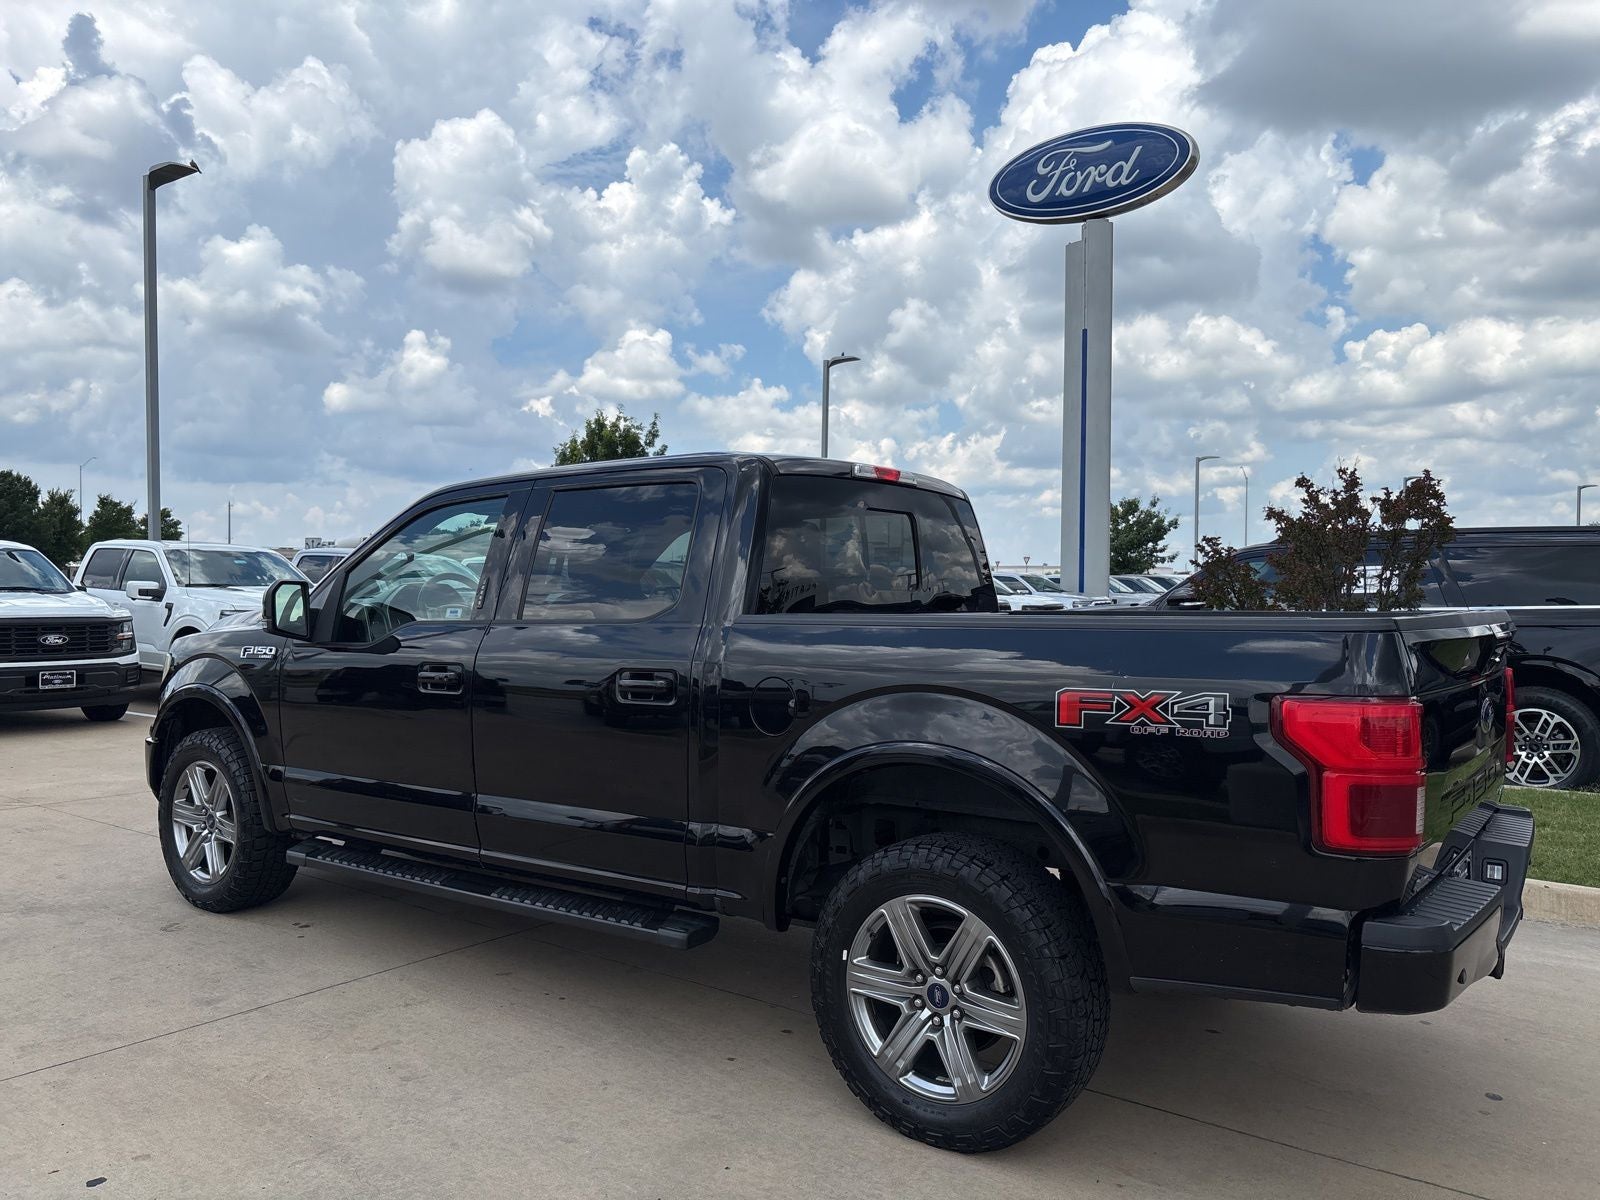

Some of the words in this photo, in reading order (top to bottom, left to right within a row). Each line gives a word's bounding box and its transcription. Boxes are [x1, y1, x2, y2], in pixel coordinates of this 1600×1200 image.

[1026, 139, 1143, 203] Ford
[1055, 687, 1232, 730] FX4
[1130, 725, 1169, 735] OFF
[1175, 727, 1230, 739] ROAD
